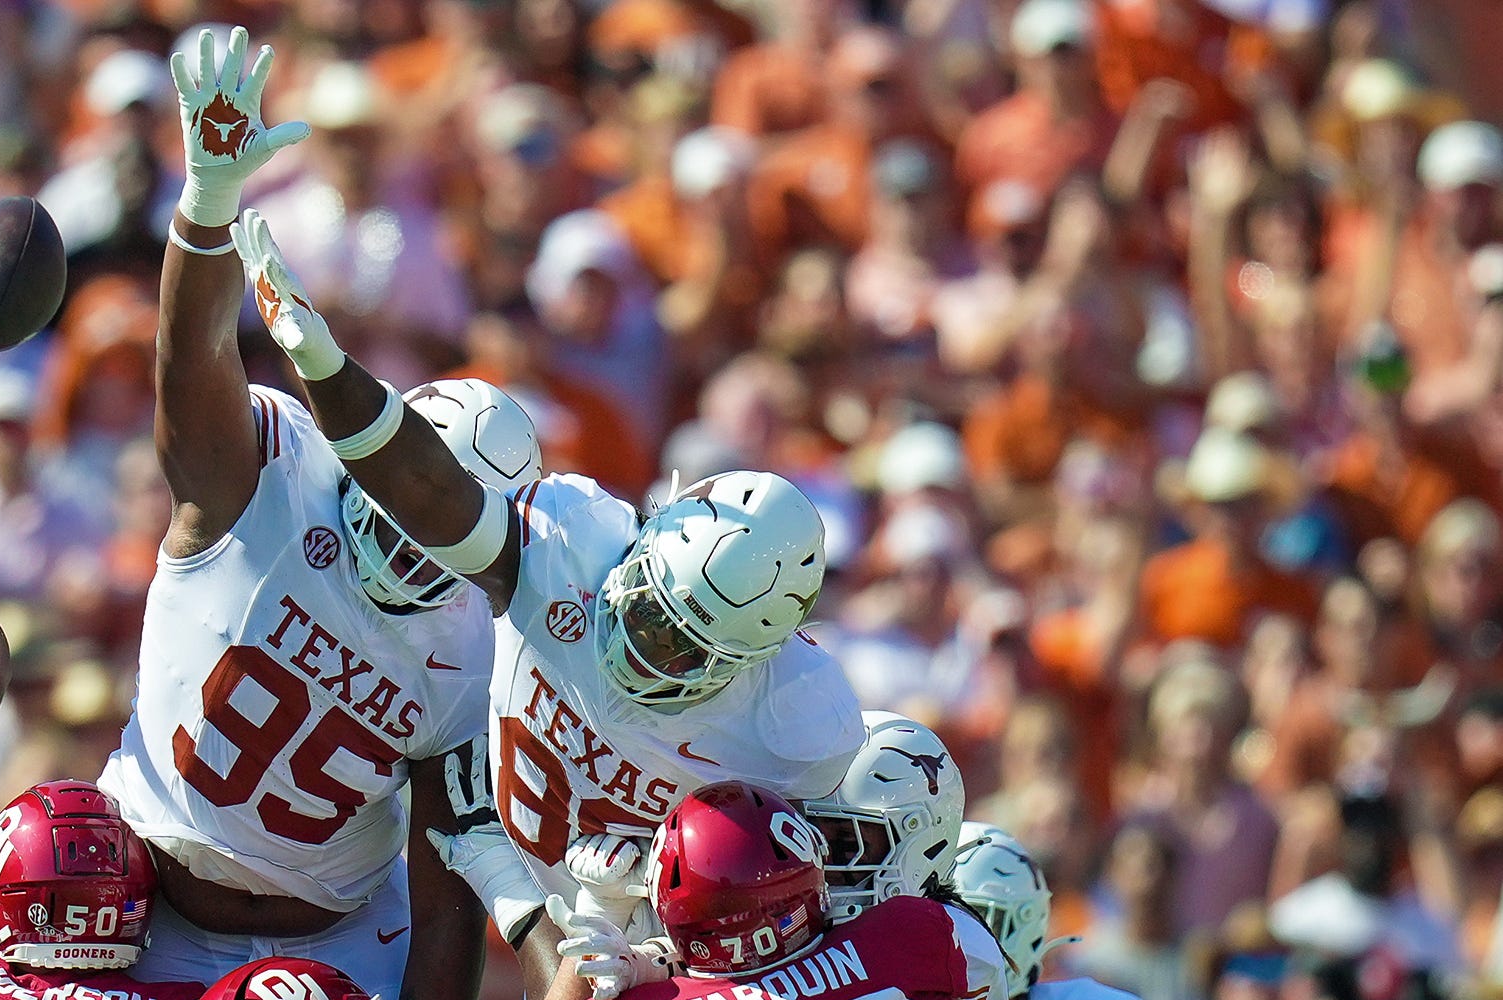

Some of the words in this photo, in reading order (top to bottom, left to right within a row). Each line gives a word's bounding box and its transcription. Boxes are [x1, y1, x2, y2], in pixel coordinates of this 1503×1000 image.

[304, 529, 340, 567] SEC
[547, 602, 586, 641] SEC
[683, 588, 717, 626] HORNS
[265, 595, 424, 741] TEXAS
[172, 645, 407, 845] 95
[523, 667, 678, 817] TEXAS
[27, 902, 49, 927] SEC
[64, 904, 118, 937] 50
[54, 947, 116, 960] SOONERS
[719, 926, 778, 964] 70
